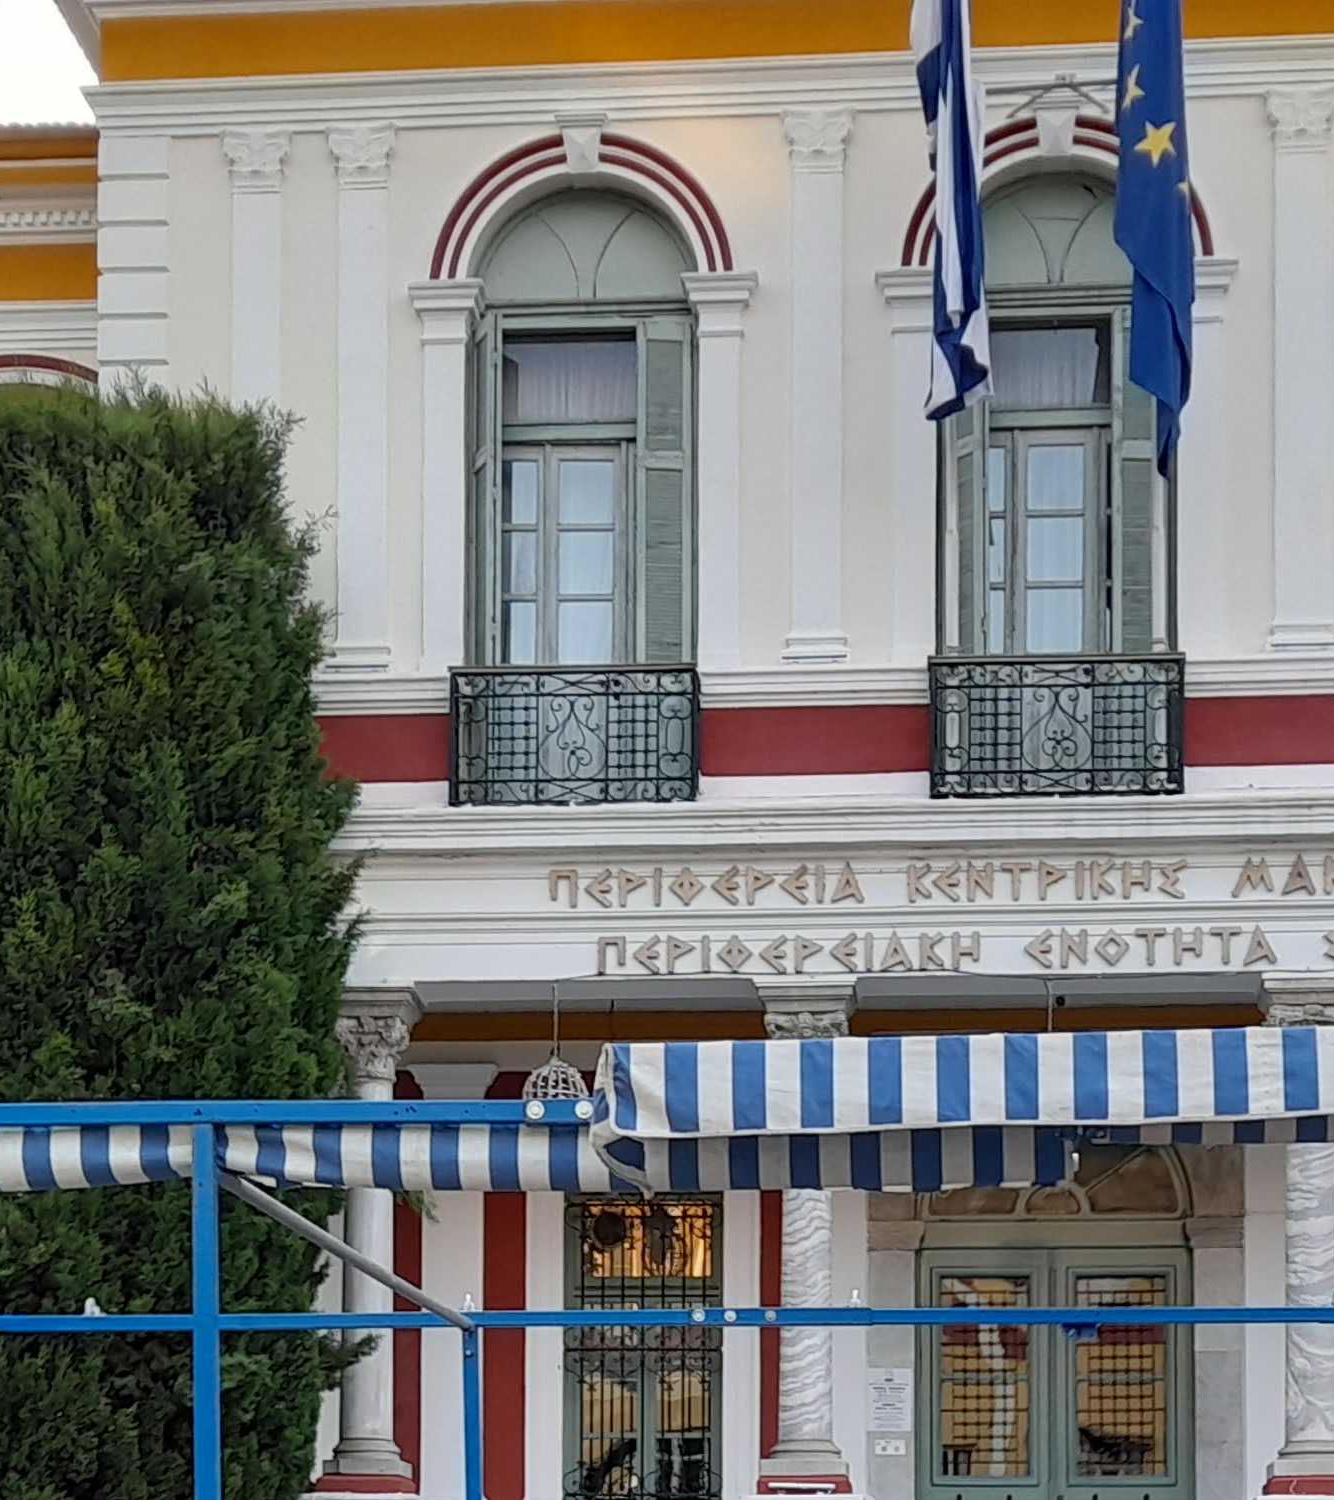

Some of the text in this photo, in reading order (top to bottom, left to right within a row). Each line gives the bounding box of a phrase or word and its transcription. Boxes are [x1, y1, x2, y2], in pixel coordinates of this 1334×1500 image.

[548, 861, 865, 908] ΠΕΡΙΦΕΡΕΙΑ
[906, 858, 1188, 903] ΚΕΝΤΡΙΚΗΣ
[597, 930, 981, 976] ΠΕΡΙΦΕΡΕΙΑΚΗ
[1023, 924, 1278, 969] ΕΝΟΤΗΤΑ
